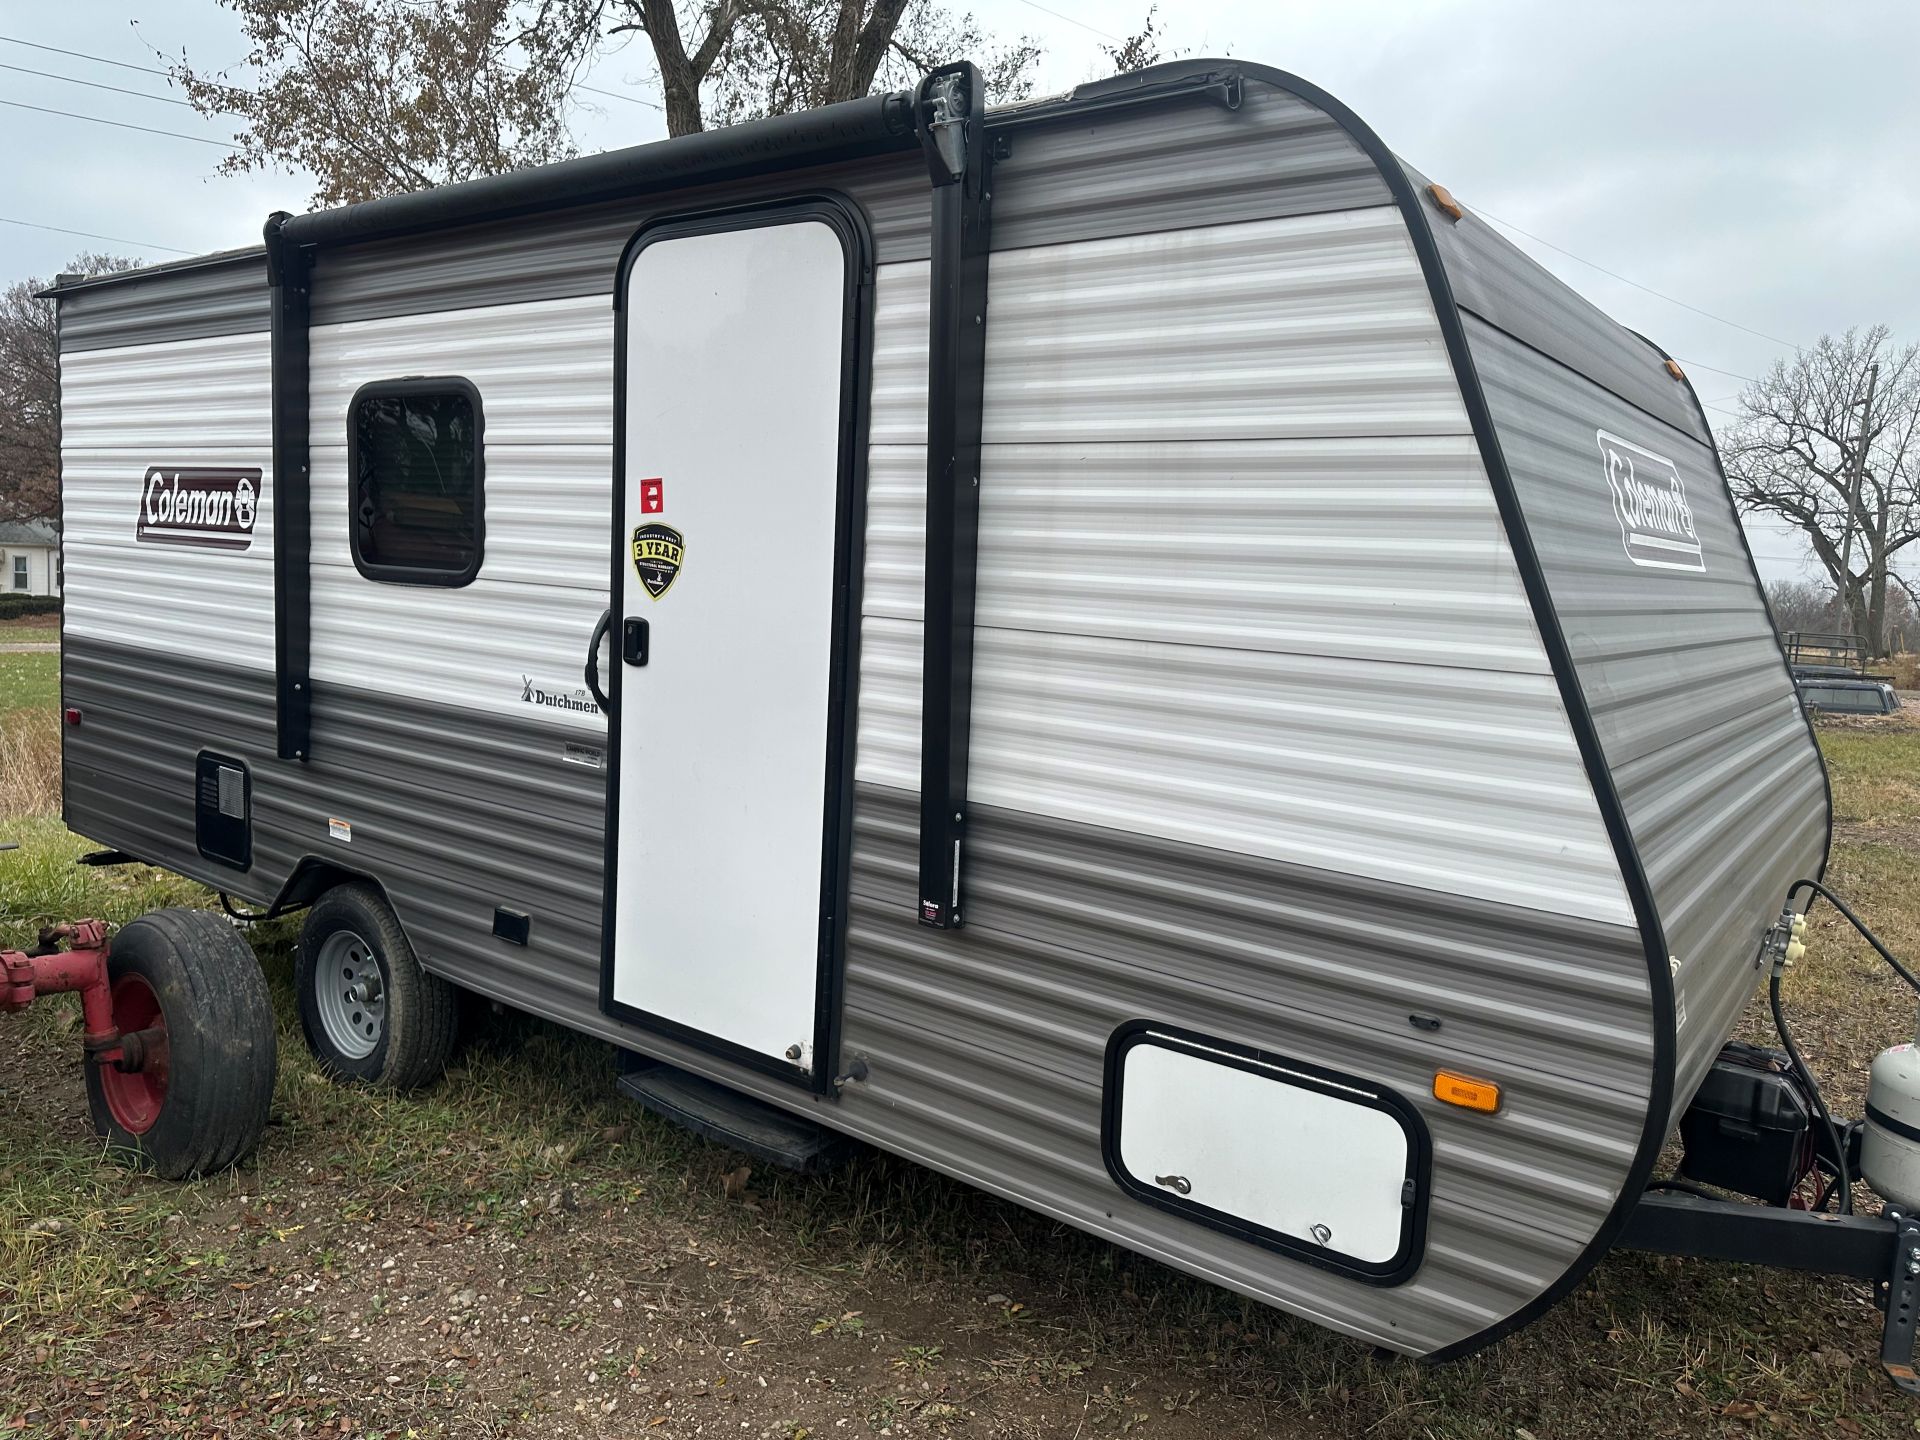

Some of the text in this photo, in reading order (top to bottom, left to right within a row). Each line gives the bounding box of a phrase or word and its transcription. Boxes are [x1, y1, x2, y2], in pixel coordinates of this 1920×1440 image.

[146, 472, 234, 526] Coleman
[636, 541, 679, 561] 3 YEAR
[535, 689, 599, 714] Dutchmen
